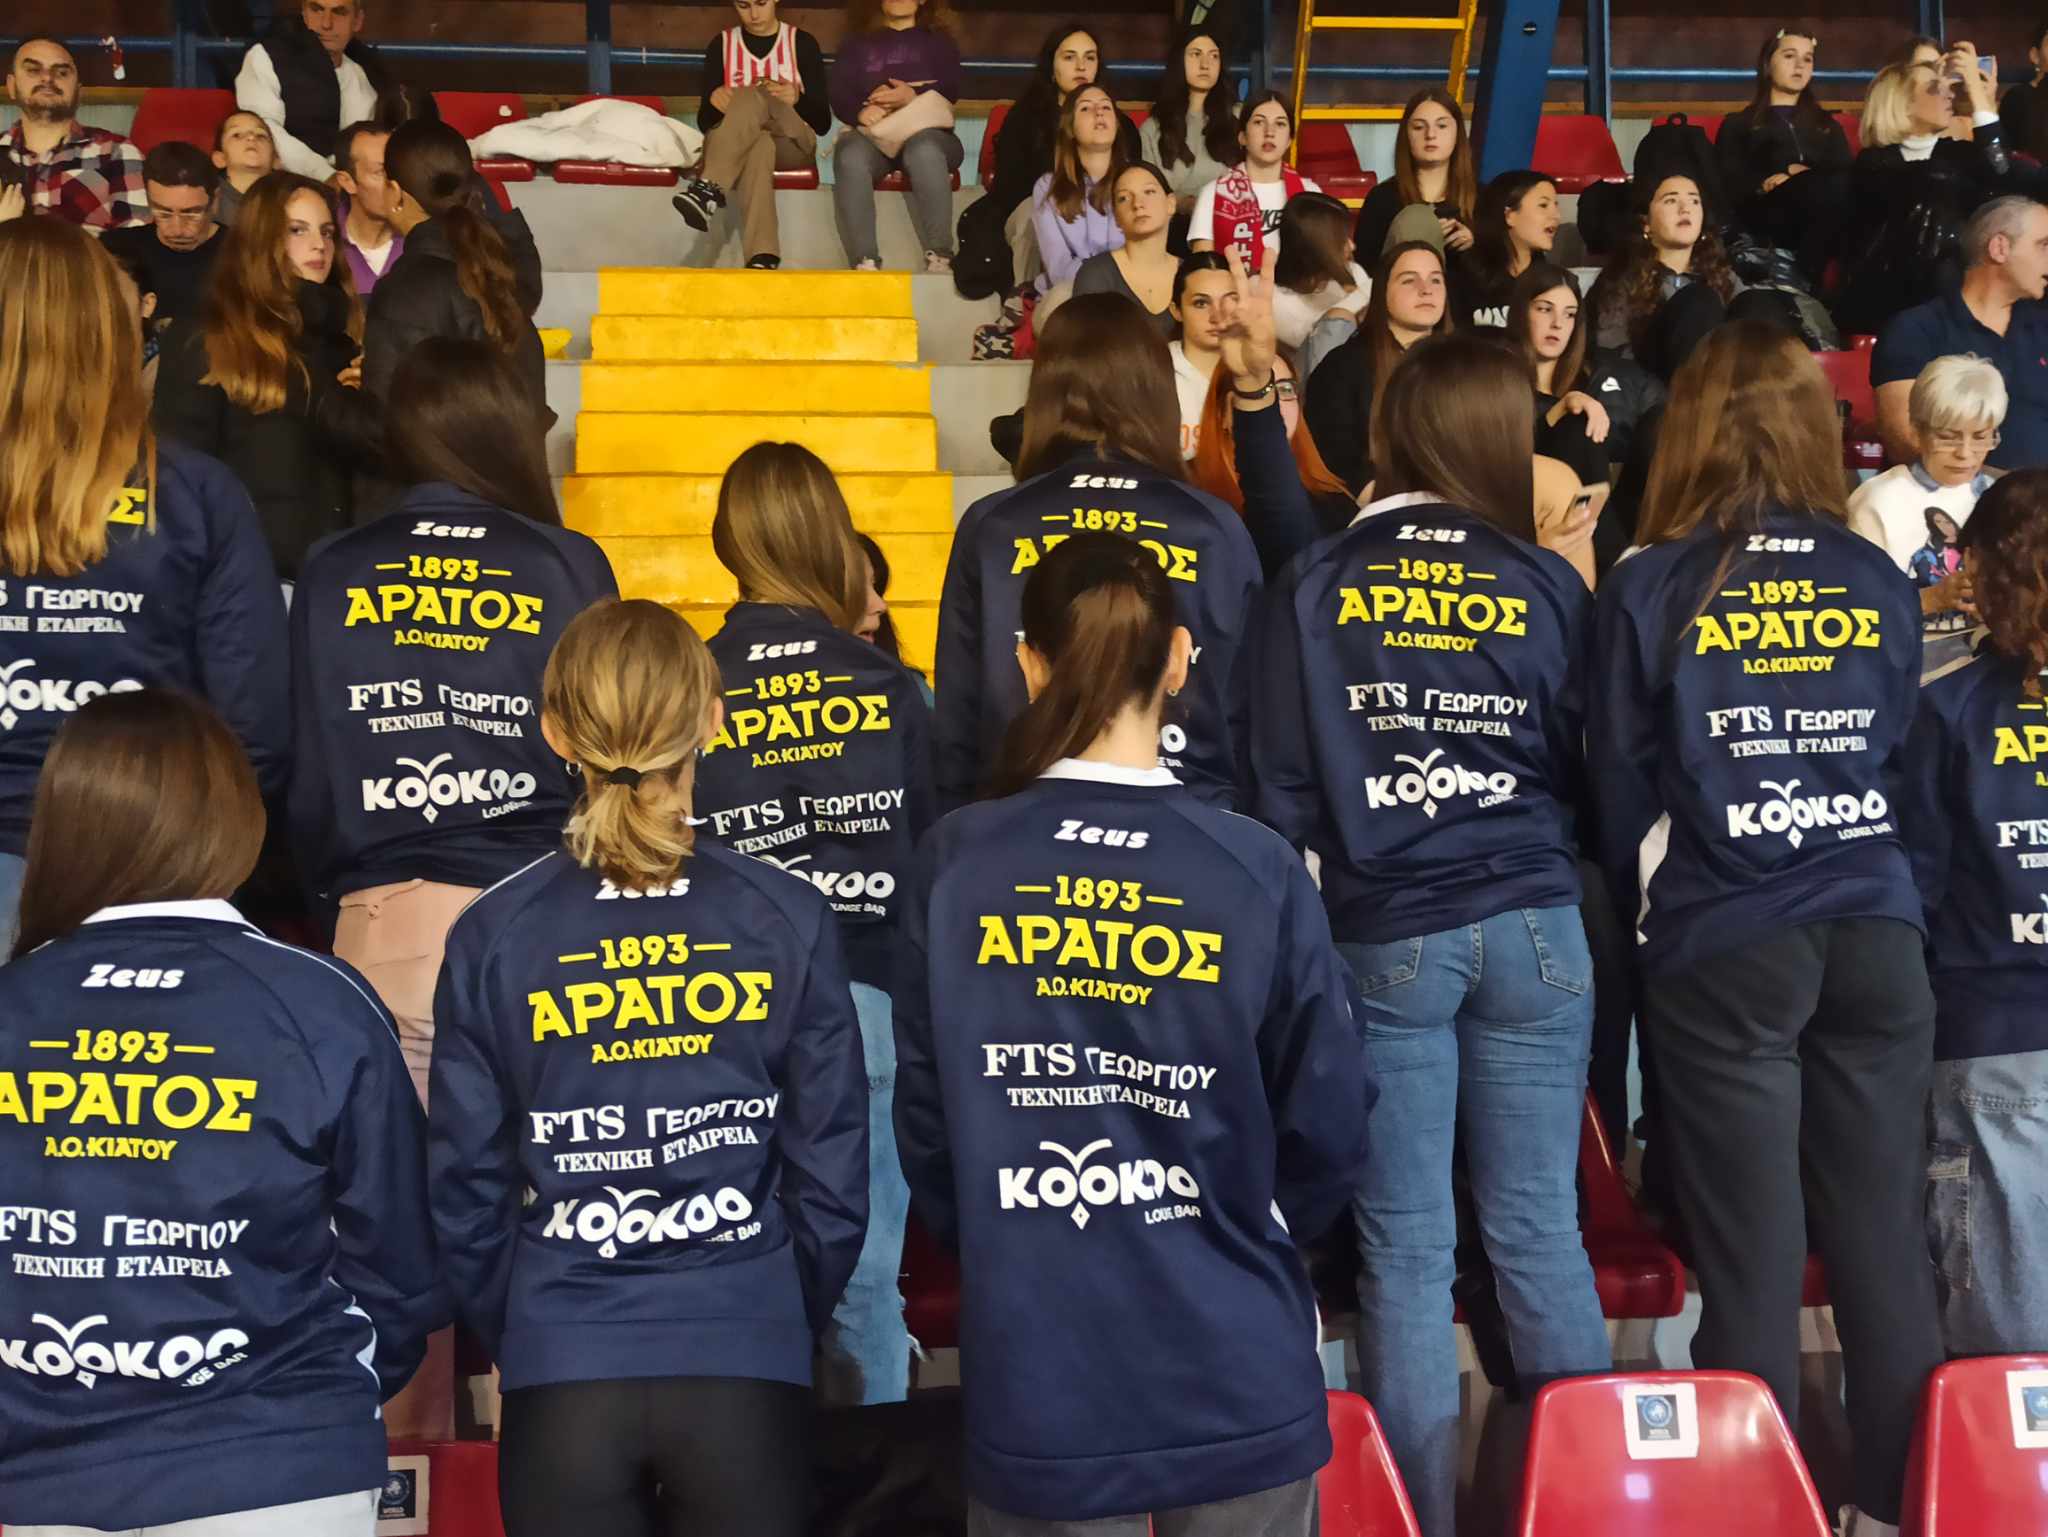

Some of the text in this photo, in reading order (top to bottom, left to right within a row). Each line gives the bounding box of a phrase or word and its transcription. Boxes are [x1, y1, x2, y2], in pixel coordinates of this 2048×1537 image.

[1069, 474, 1139, 490] Zeus
[411, 521, 487, 539] Zeus
[1072, 508, 1137, 532] 1893
[1396, 525, 1468, 543] Zeus
[1745, 534, 1815, 552] Zeus
[408, 555, 480, 582] 1893
[1399, 558, 1465, 586] 1893
[1749, 580, 1816, 604] 1893
[344, 584, 543, 635] ΑΡΑΤΟΣ
[1337, 586, 1528, 636] ΑΡΑΤΟΣ
[1695, 608, 1881, 655] ΑΡΑΤΟΣ
[747, 640, 818, 662] Zeus
[347, 678, 424, 711] FTS
[755, 670, 822, 700] 1893
[1346, 682, 1528, 716] FTS ΓΕΩΡΓΙΟΥ
[368, 711, 523, 738] ΤΕΧΝΙΚΗ ΕΤΑΙΡΕΙΑ
[1432, 717, 1511, 737] ΕΤΑΙΡΕΙΑ
[1706, 706, 1773, 737] FTS
[362, 768, 536, 812] KOOKOO
[711, 788, 904, 836] FTS ΓΕΩΡΓΙΟΥ
[1727, 789, 1888, 838] KOOKOO
[734, 817, 891, 854] ΤΕΧΝΙΚΗ ΕΤΑΙΡΕΙΑ
[1054, 820, 1149, 849] Zeus
[1055, 875, 1143, 912] 1893
[864, 903, 886, 916] BAR
[600, 934, 689, 970] 1893
[977, 915, 1222, 983] ΑΡΑΤΟΣ
[81, 963, 184, 989] Zeus
[1036, 976, 1152, 1005] Α.Ο.ΚΙΑΤΟΥ
[527, 971, 773, 1042] ΑΡΑΤΟΣ
[72, 1029, 170, 1064] 1893
[591, 1033, 714, 1064] Α.Ο.ΚΙΑΤΟΥ
[981, 1043, 1076, 1077] FTS
[0, 1071, 257, 1132] ΑΡΑΤΟΣ
[1007, 1085, 1105, 1107] ΤΕΧΝΙΚΗ
[529, 1093, 779, 1144] FTS ΓΕΩΡΓΙΟΥ
[44, 1136, 178, 1161] Α.Ο.ΚΙΑΤΟΥ
[554, 1126, 759, 1173] ΤΕΧΝΙΚΗ ΕΤΑΙΡΕΙΑ
[542, 1187, 752, 1243] KOOKOO
[1174, 1204, 1201, 1220] BAR
[0, 1206, 250, 1251] FTS ΓΕΩΡΓΙΟΥ
[736, 1221, 761, 1240] BAR
[13, 1253, 232, 1279] ΤΕΧΝΙΚΗ ΕΤΑΙΡΕΙΑ
